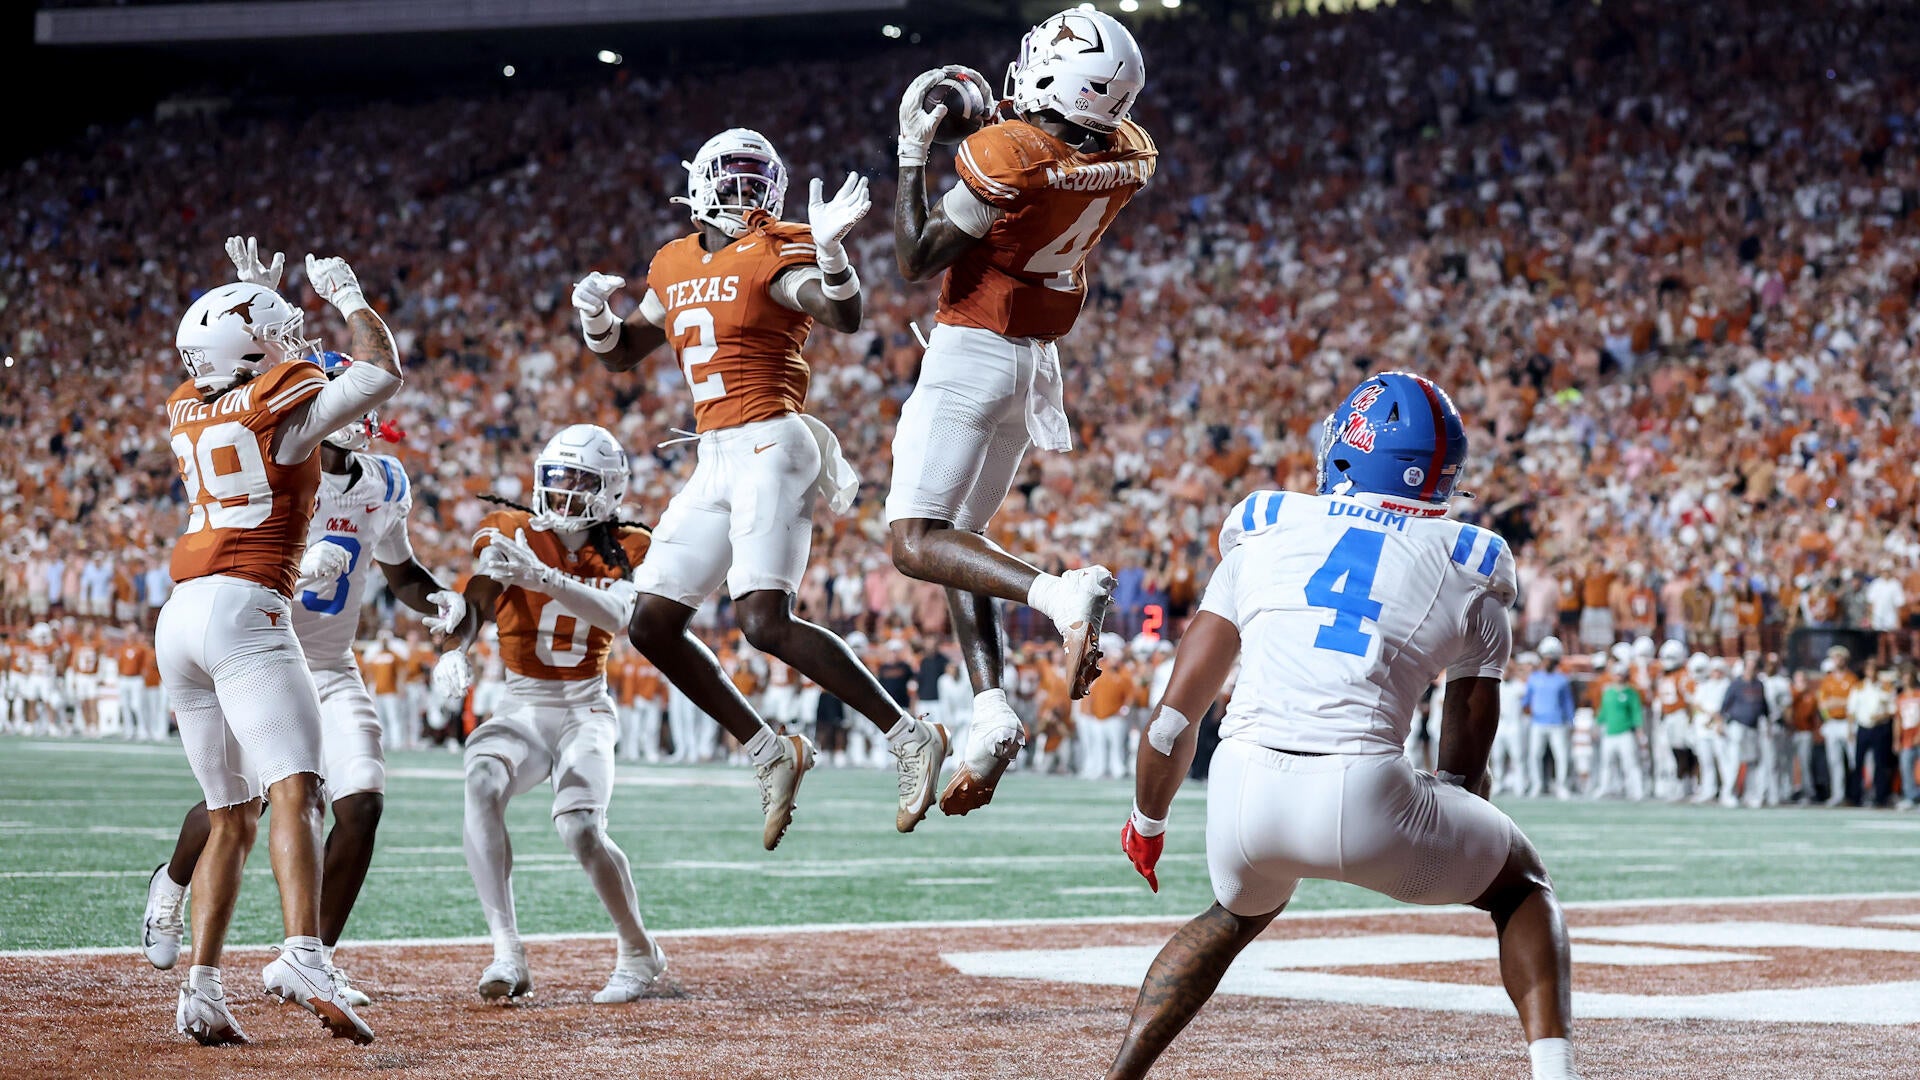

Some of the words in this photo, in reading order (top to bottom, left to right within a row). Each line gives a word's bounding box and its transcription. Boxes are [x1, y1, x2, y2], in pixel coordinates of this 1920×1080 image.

[1108, 91, 1130, 118] 4
[1023, 196, 1111, 291] 4
[666, 276, 739, 310] TEXAS
[673, 307, 727, 403] 2
[1351, 385, 1386, 412] Ole
[1341, 411, 1377, 454] Miss
[170, 420, 273, 535] 29
[326, 518, 339, 532] Ole
[340, 518, 359, 533] Miss
[1328, 501, 1408, 532] DOOM
[1381, 500, 1420, 515] HOTTY
[301, 535, 361, 616] 3
[1304, 527, 1387, 658] 4
[535, 598, 592, 667] 0
[1142, 604, 1163, 642] 2
